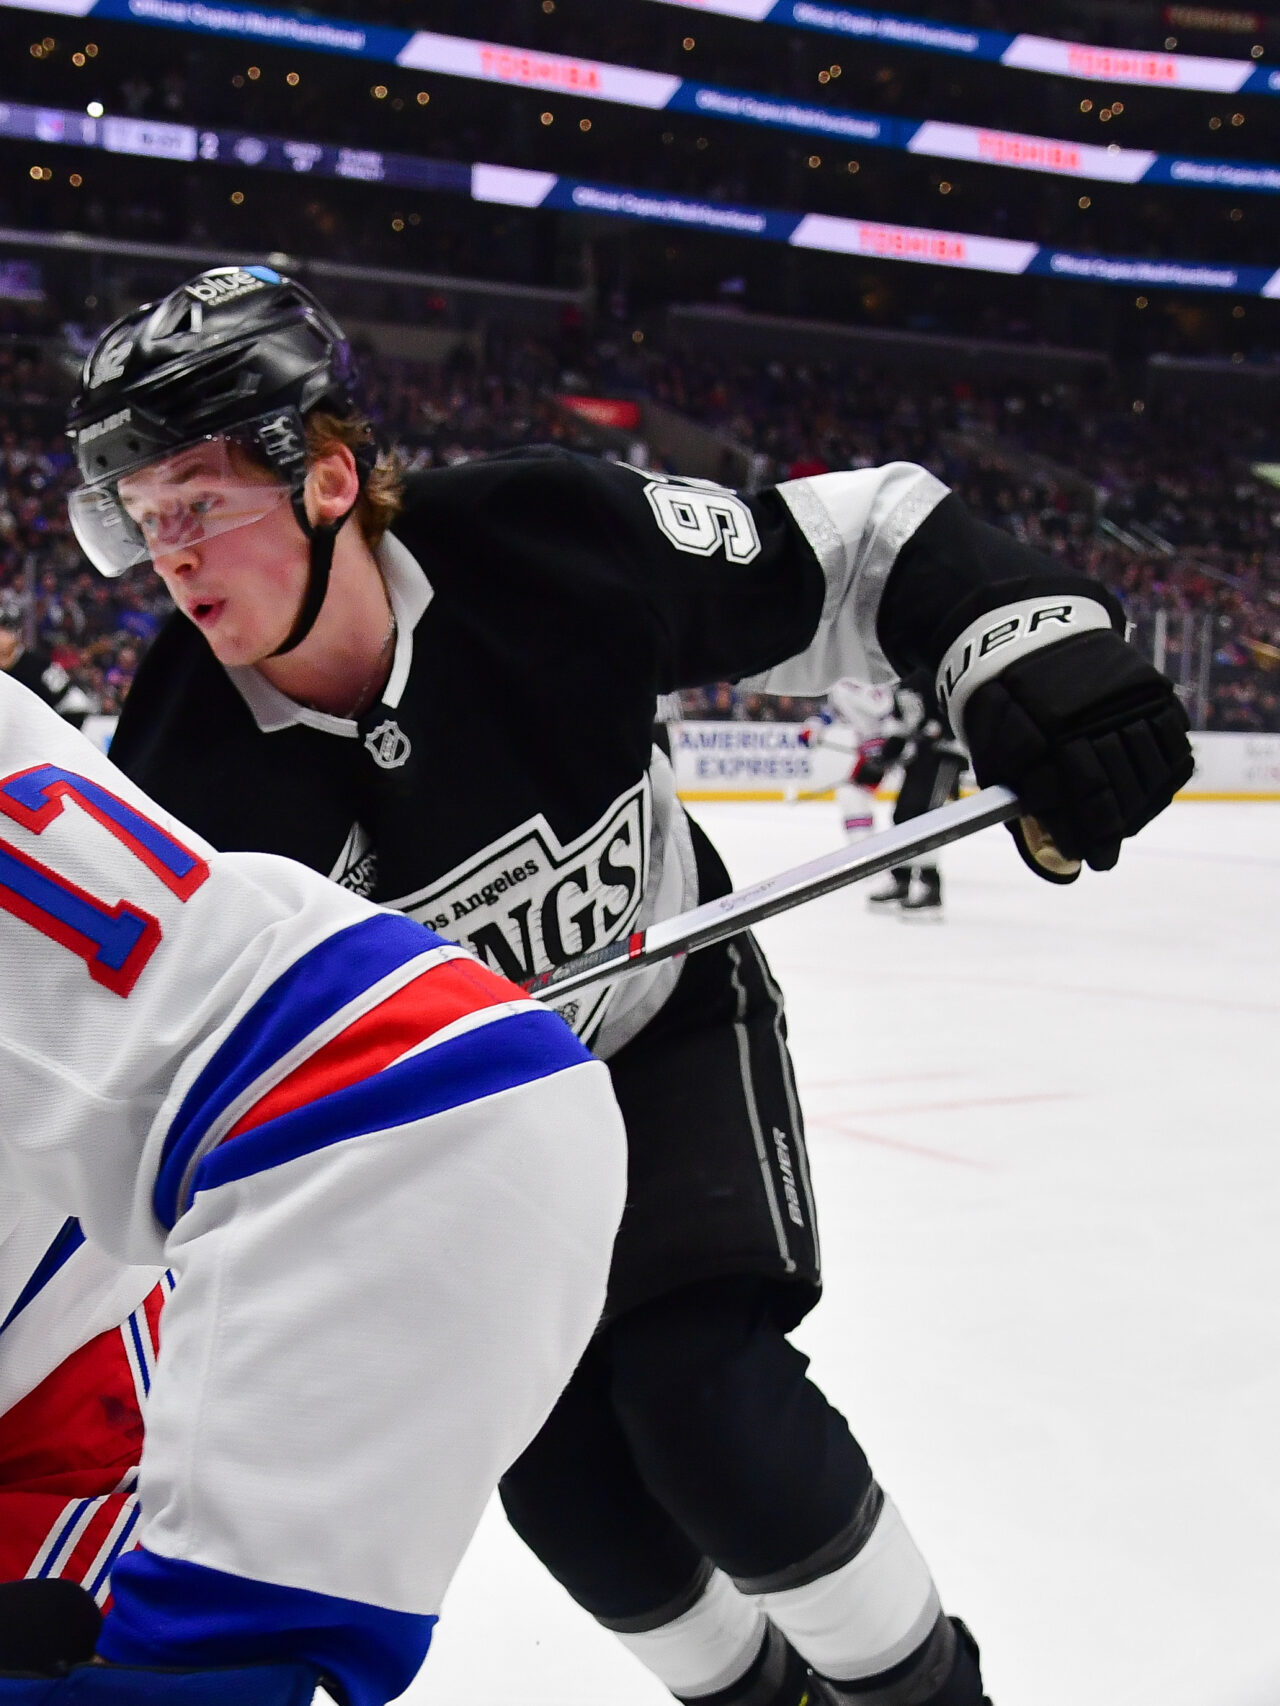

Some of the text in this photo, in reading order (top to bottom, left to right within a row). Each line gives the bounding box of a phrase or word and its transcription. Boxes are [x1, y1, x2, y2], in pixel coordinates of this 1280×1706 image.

[479, 47, 601, 94] TOSHIBA
[697, 758, 812, 778] EXPRESS
[451, 859, 540, 922] Angeles
[464, 820, 637, 984] NGS
